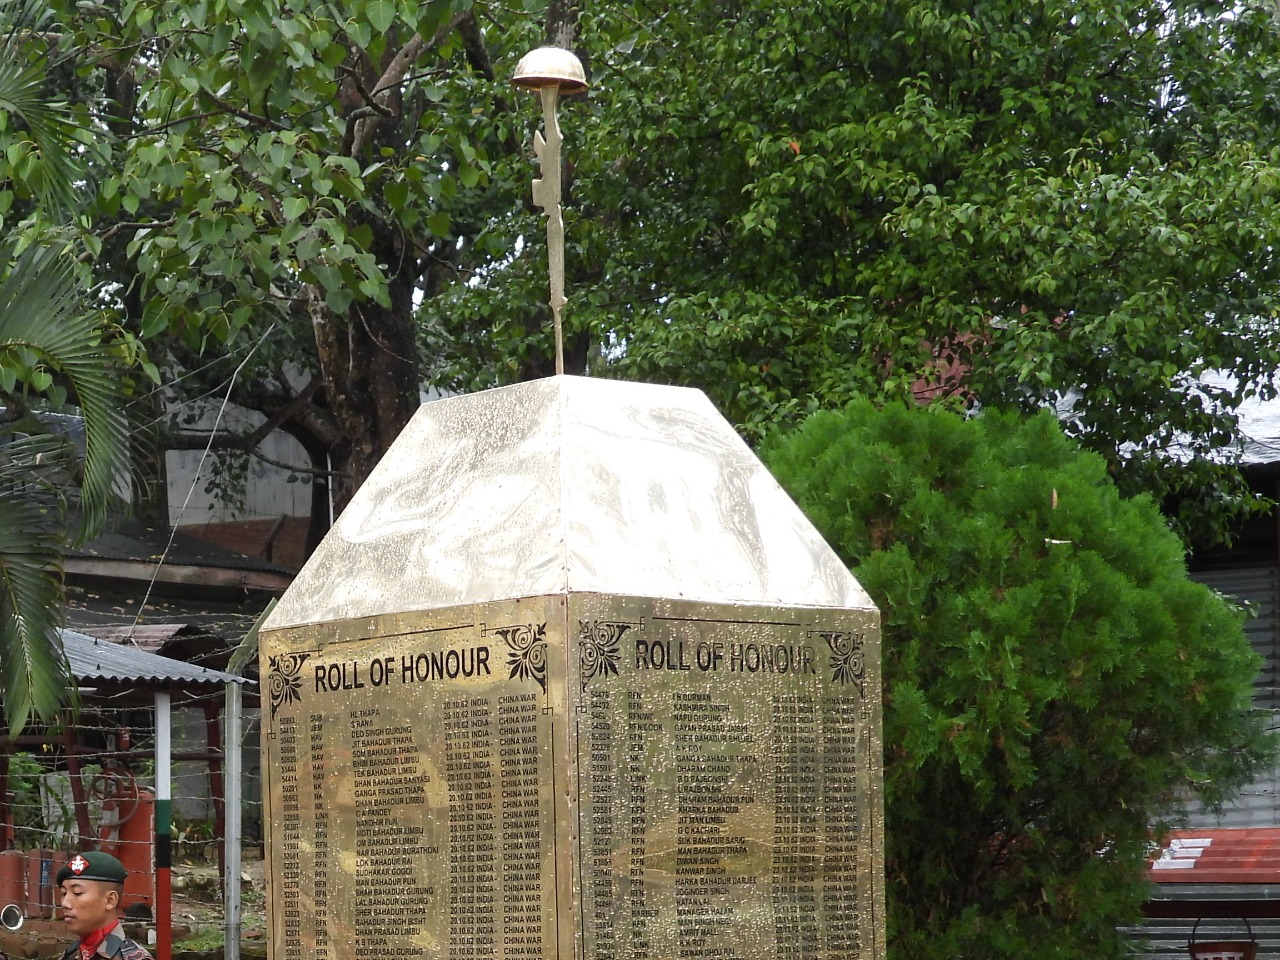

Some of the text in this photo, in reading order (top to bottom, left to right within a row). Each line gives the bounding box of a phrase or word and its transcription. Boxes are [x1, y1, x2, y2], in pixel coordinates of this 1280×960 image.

[314, 645, 490, 692] ROLL OF HONOUR
[635, 639, 816, 675] ROLL OF HONOUR
[359, 708, 380, 717] THAPA
[498, 695, 519, 704] CHINA
[520, 693, 536, 702] WAR
[365, 728, 384, 737] SINGH
[384, 726, 411, 735] GURUNG
[498, 716, 519, 725] CHINA
[520, 714, 536, 723] WAR
[311, 753, 323, 761] HAV
[352, 749, 365, 757] SOM
[367, 747, 396, 756] BAHADUR
[398, 746, 418, 754] THAPA
[499, 737, 520, 745] CHINA
[521, 736, 537, 744] WAR
[312, 772, 324, 780] HAV
[366, 767, 396, 776] BAHADUR
[500, 758, 521, 766] CHINA
[522, 757, 537, 765] WAR
[354, 789, 376, 797] GANGA
[378, 787, 403, 795] PRASAD
[404, 786, 424, 794] THAPA
[501, 779, 522, 787] CHINA
[522, 778, 538, 786] WAR
[370, 847, 400, 856] BAHADUR
[370, 858, 400, 866] BAHADUR
[401, 857, 412, 865] RAI
[355, 897, 428, 906] LAL BAHADUR GURUNG
[355, 918, 385, 926] BAHADUR
